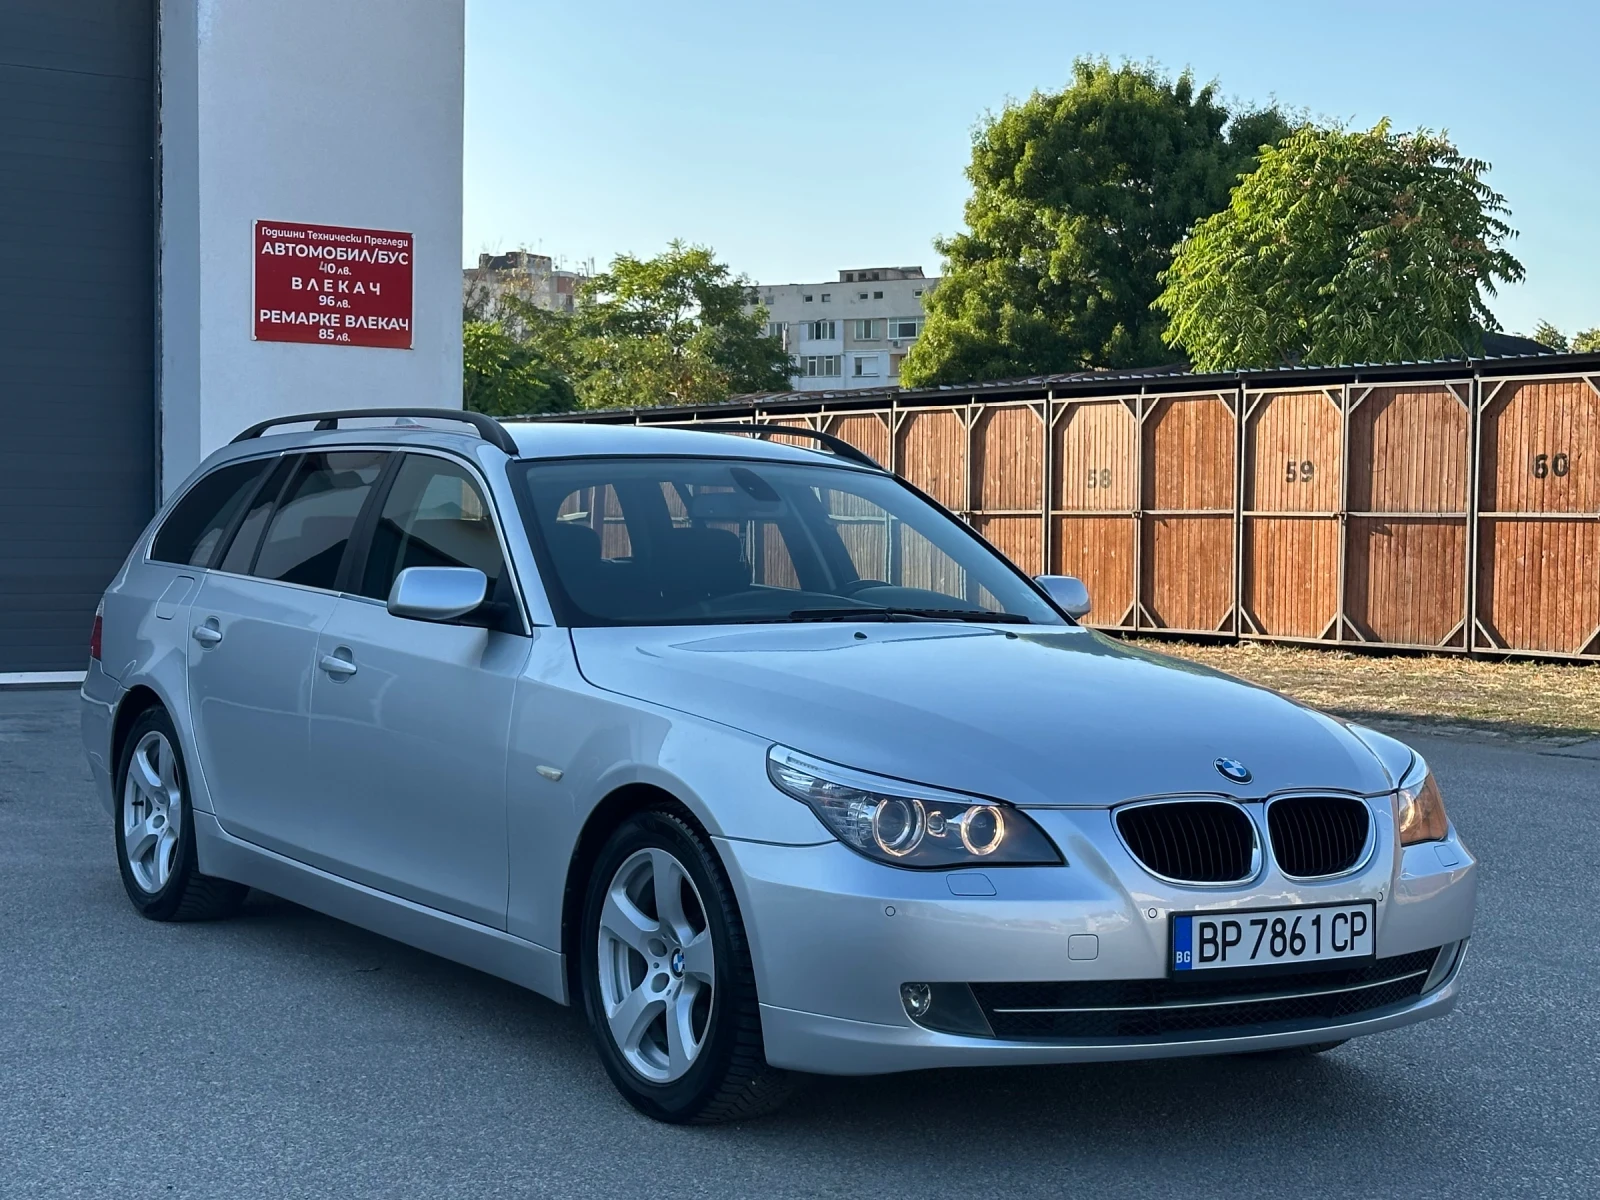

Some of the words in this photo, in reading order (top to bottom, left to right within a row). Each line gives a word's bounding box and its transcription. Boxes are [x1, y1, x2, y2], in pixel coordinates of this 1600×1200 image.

[261, 226, 305, 239] Годишни
[307, 230, 362, 244] Технически
[364, 235, 409, 249] Прегледи
[261, 241, 409, 265] АВТОМОБИЛ/БУС
[318, 261, 336, 274] 40
[337, 266, 352, 276] лв.
[291, 276, 381, 296] ВЛЕКАЧ
[318, 295, 335, 306] 96
[336, 299, 351, 309] лв.
[260, 309, 341, 327] РЕМАРКЕ
[345, 315, 409, 331] ВЛЕКАЧ
[318, 328, 335, 340] 85
[336, 333, 351, 342] лв.
[1285, 460, 1314, 483] 59
[1532, 453, 1569, 479] 60
[1087, 468, 1111, 489] 58
[1249, 914, 1322, 960] 7861
[1175, 950, 1191, 964] BG
